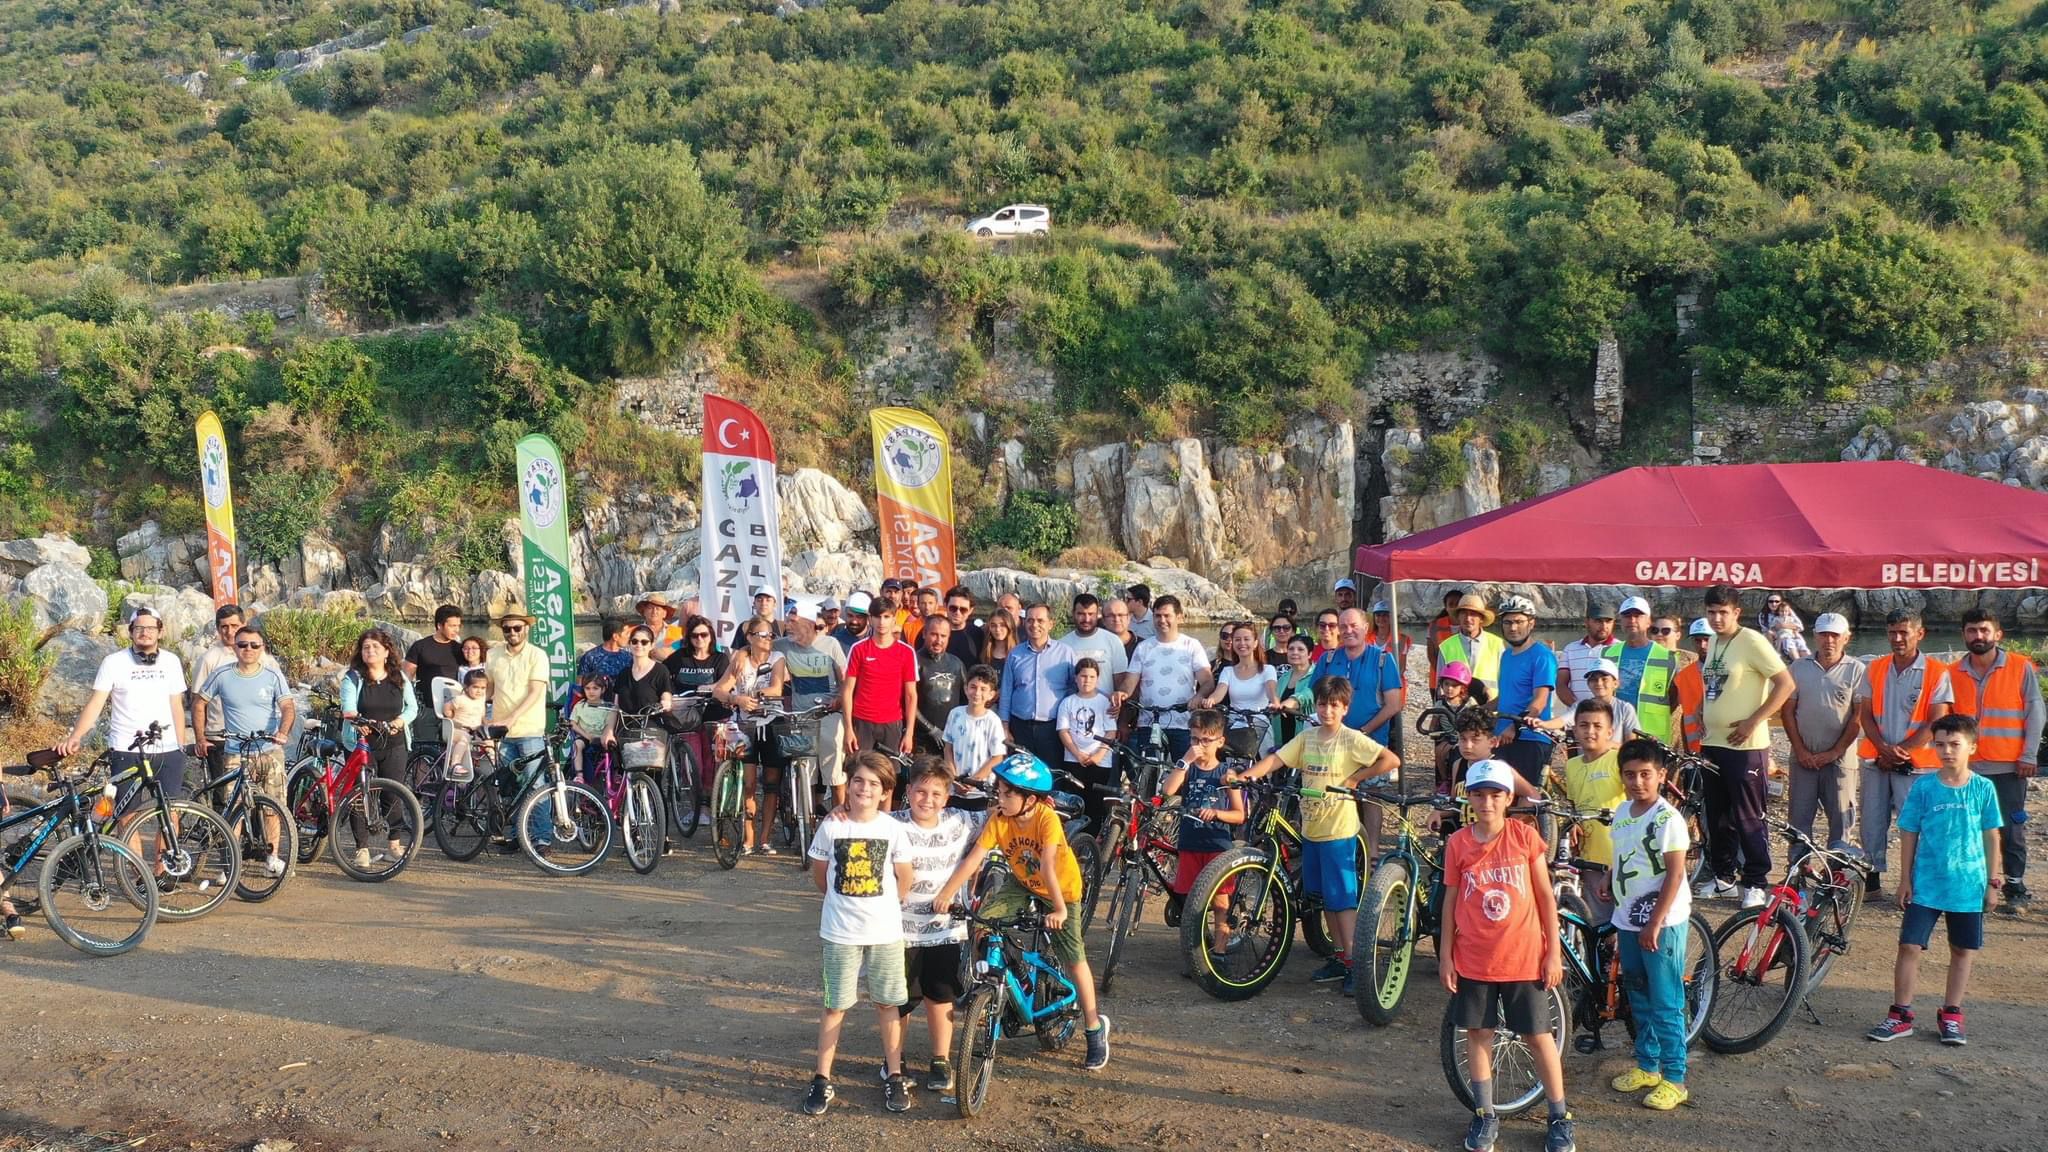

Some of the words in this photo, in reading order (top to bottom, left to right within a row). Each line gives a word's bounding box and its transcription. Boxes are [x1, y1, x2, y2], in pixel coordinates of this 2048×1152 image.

[714, 518, 741, 640] GAZİP
[1634, 556, 1764, 584] GAZİPAŞA
[1881, 557, 2039, 583] BELEDİYESİ
